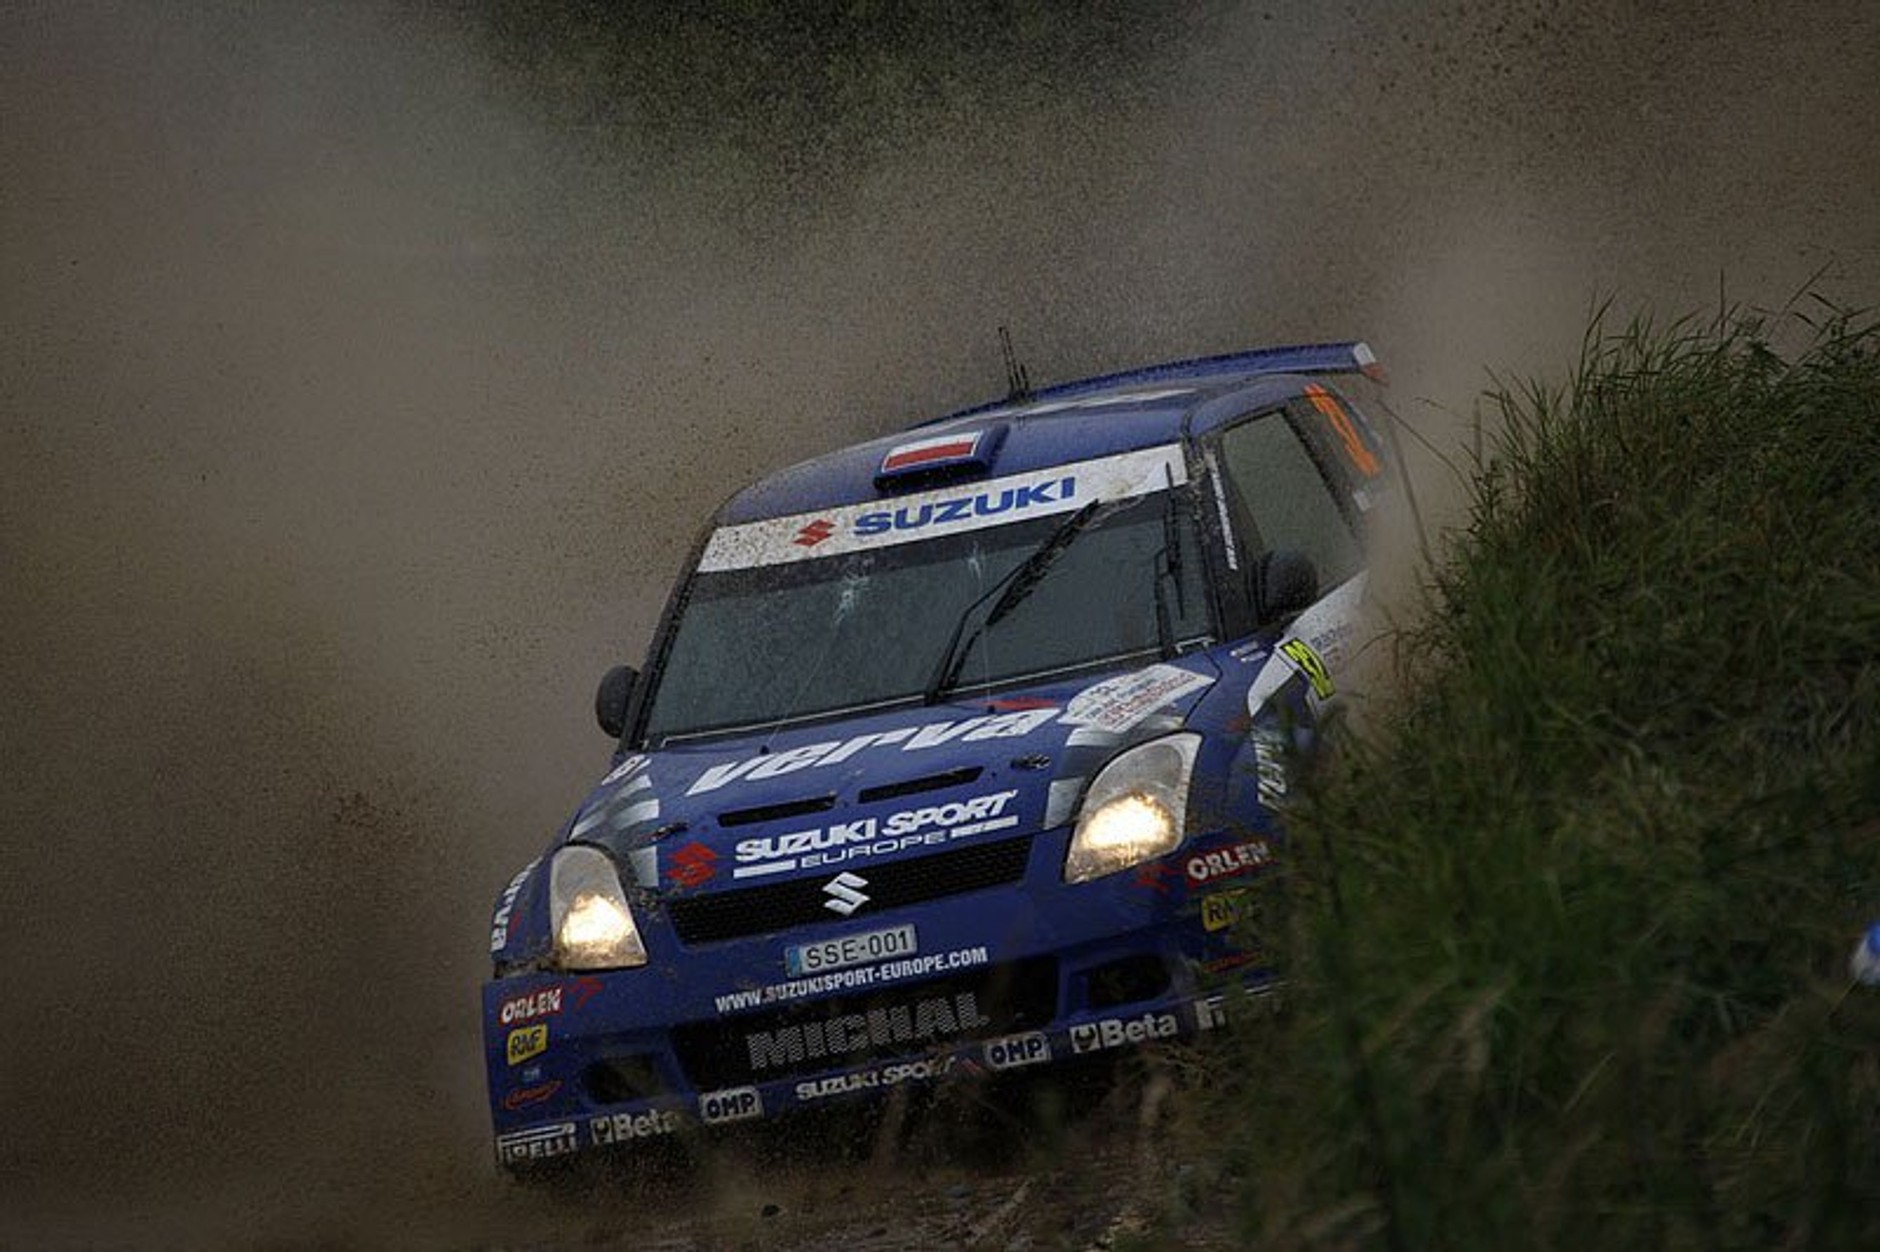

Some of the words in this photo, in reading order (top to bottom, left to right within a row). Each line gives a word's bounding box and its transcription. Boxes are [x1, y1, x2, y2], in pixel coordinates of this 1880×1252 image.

[853, 477, 1075, 536] SUZUKI
[686, 706, 1062, 797] verva
[735, 817, 877, 863] SUZUKI
[881, 789, 1018, 837] SPORT
[801, 829, 947, 868] EUROPE
[1187, 842, 1269, 880] ORLEN
[806, 932, 908, 968] SSE-001
[715, 946, 988, 1013] WWW.SUZUKISPORT-EUROPE.COM
[501, 988, 562, 1024] ORLEN
[1100, 1013, 1178, 1047] Beta
[991, 1038, 1043, 1067] OMP
[795, 1071, 879, 1100] SUZUKI
[705, 1096, 756, 1120] OMP
